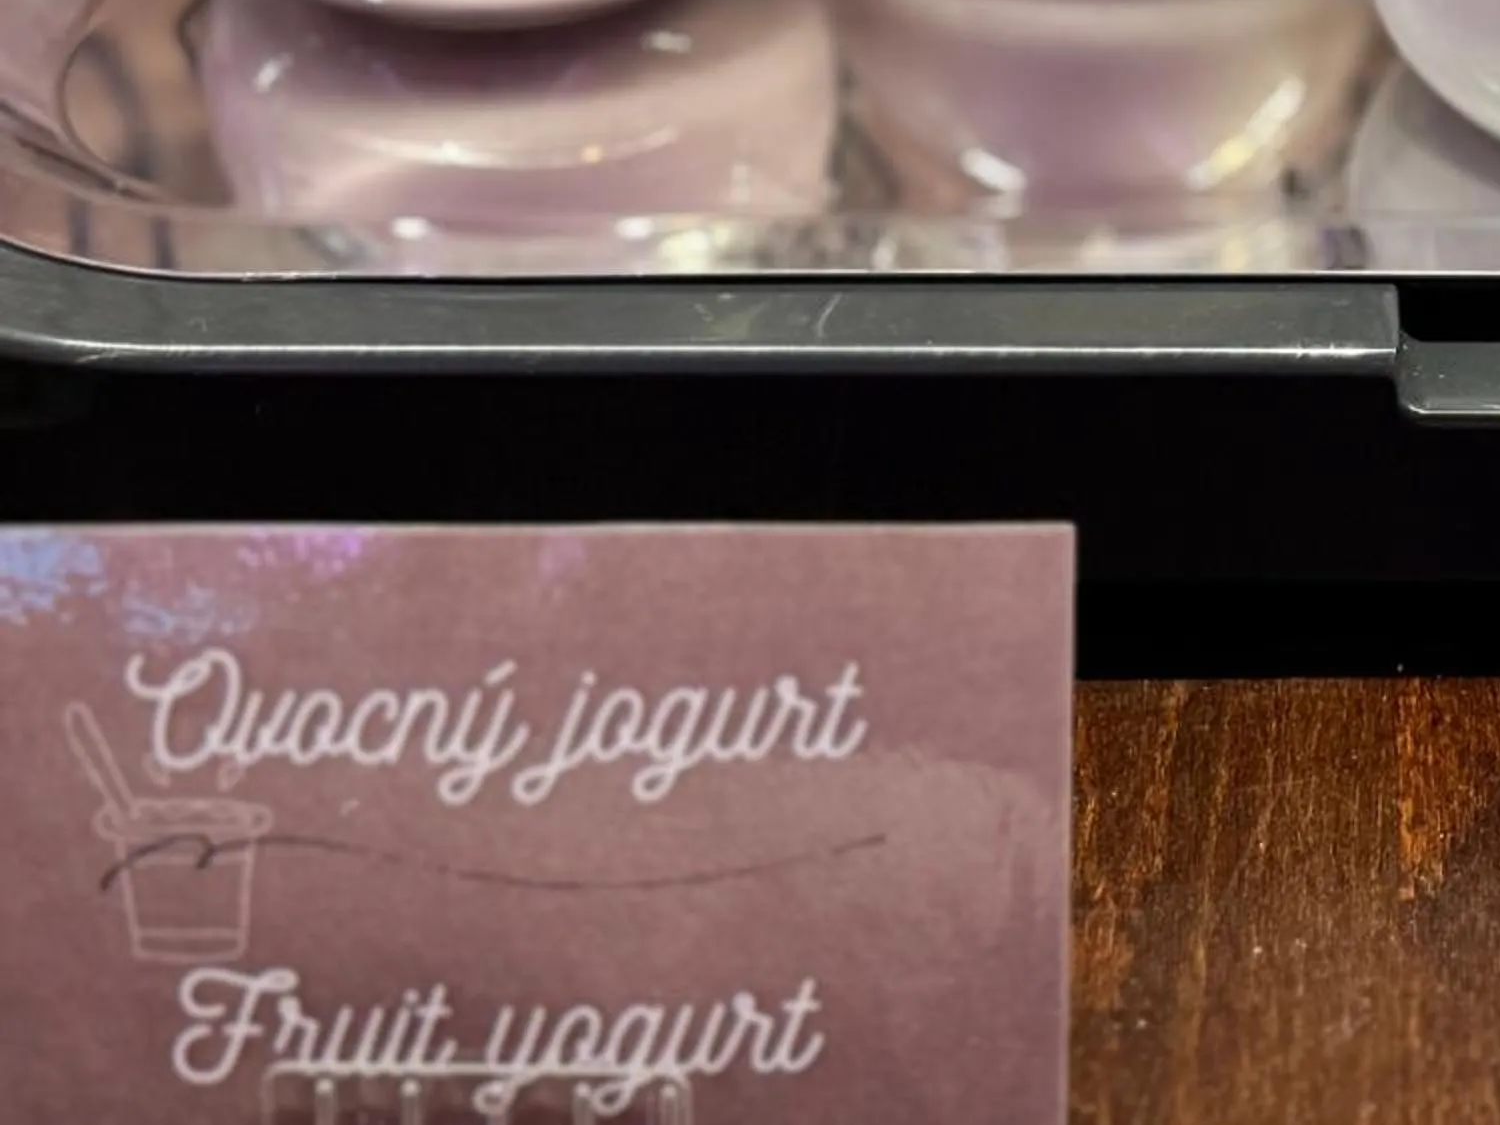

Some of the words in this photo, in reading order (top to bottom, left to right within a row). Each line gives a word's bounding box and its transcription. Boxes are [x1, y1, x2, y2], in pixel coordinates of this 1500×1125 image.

[126, 647, 528, 805] Ovocný
[512, 662, 867, 804] jogurt
[171, 967, 458, 1085] Fruit
[471, 978, 826, 1116] yogurt
